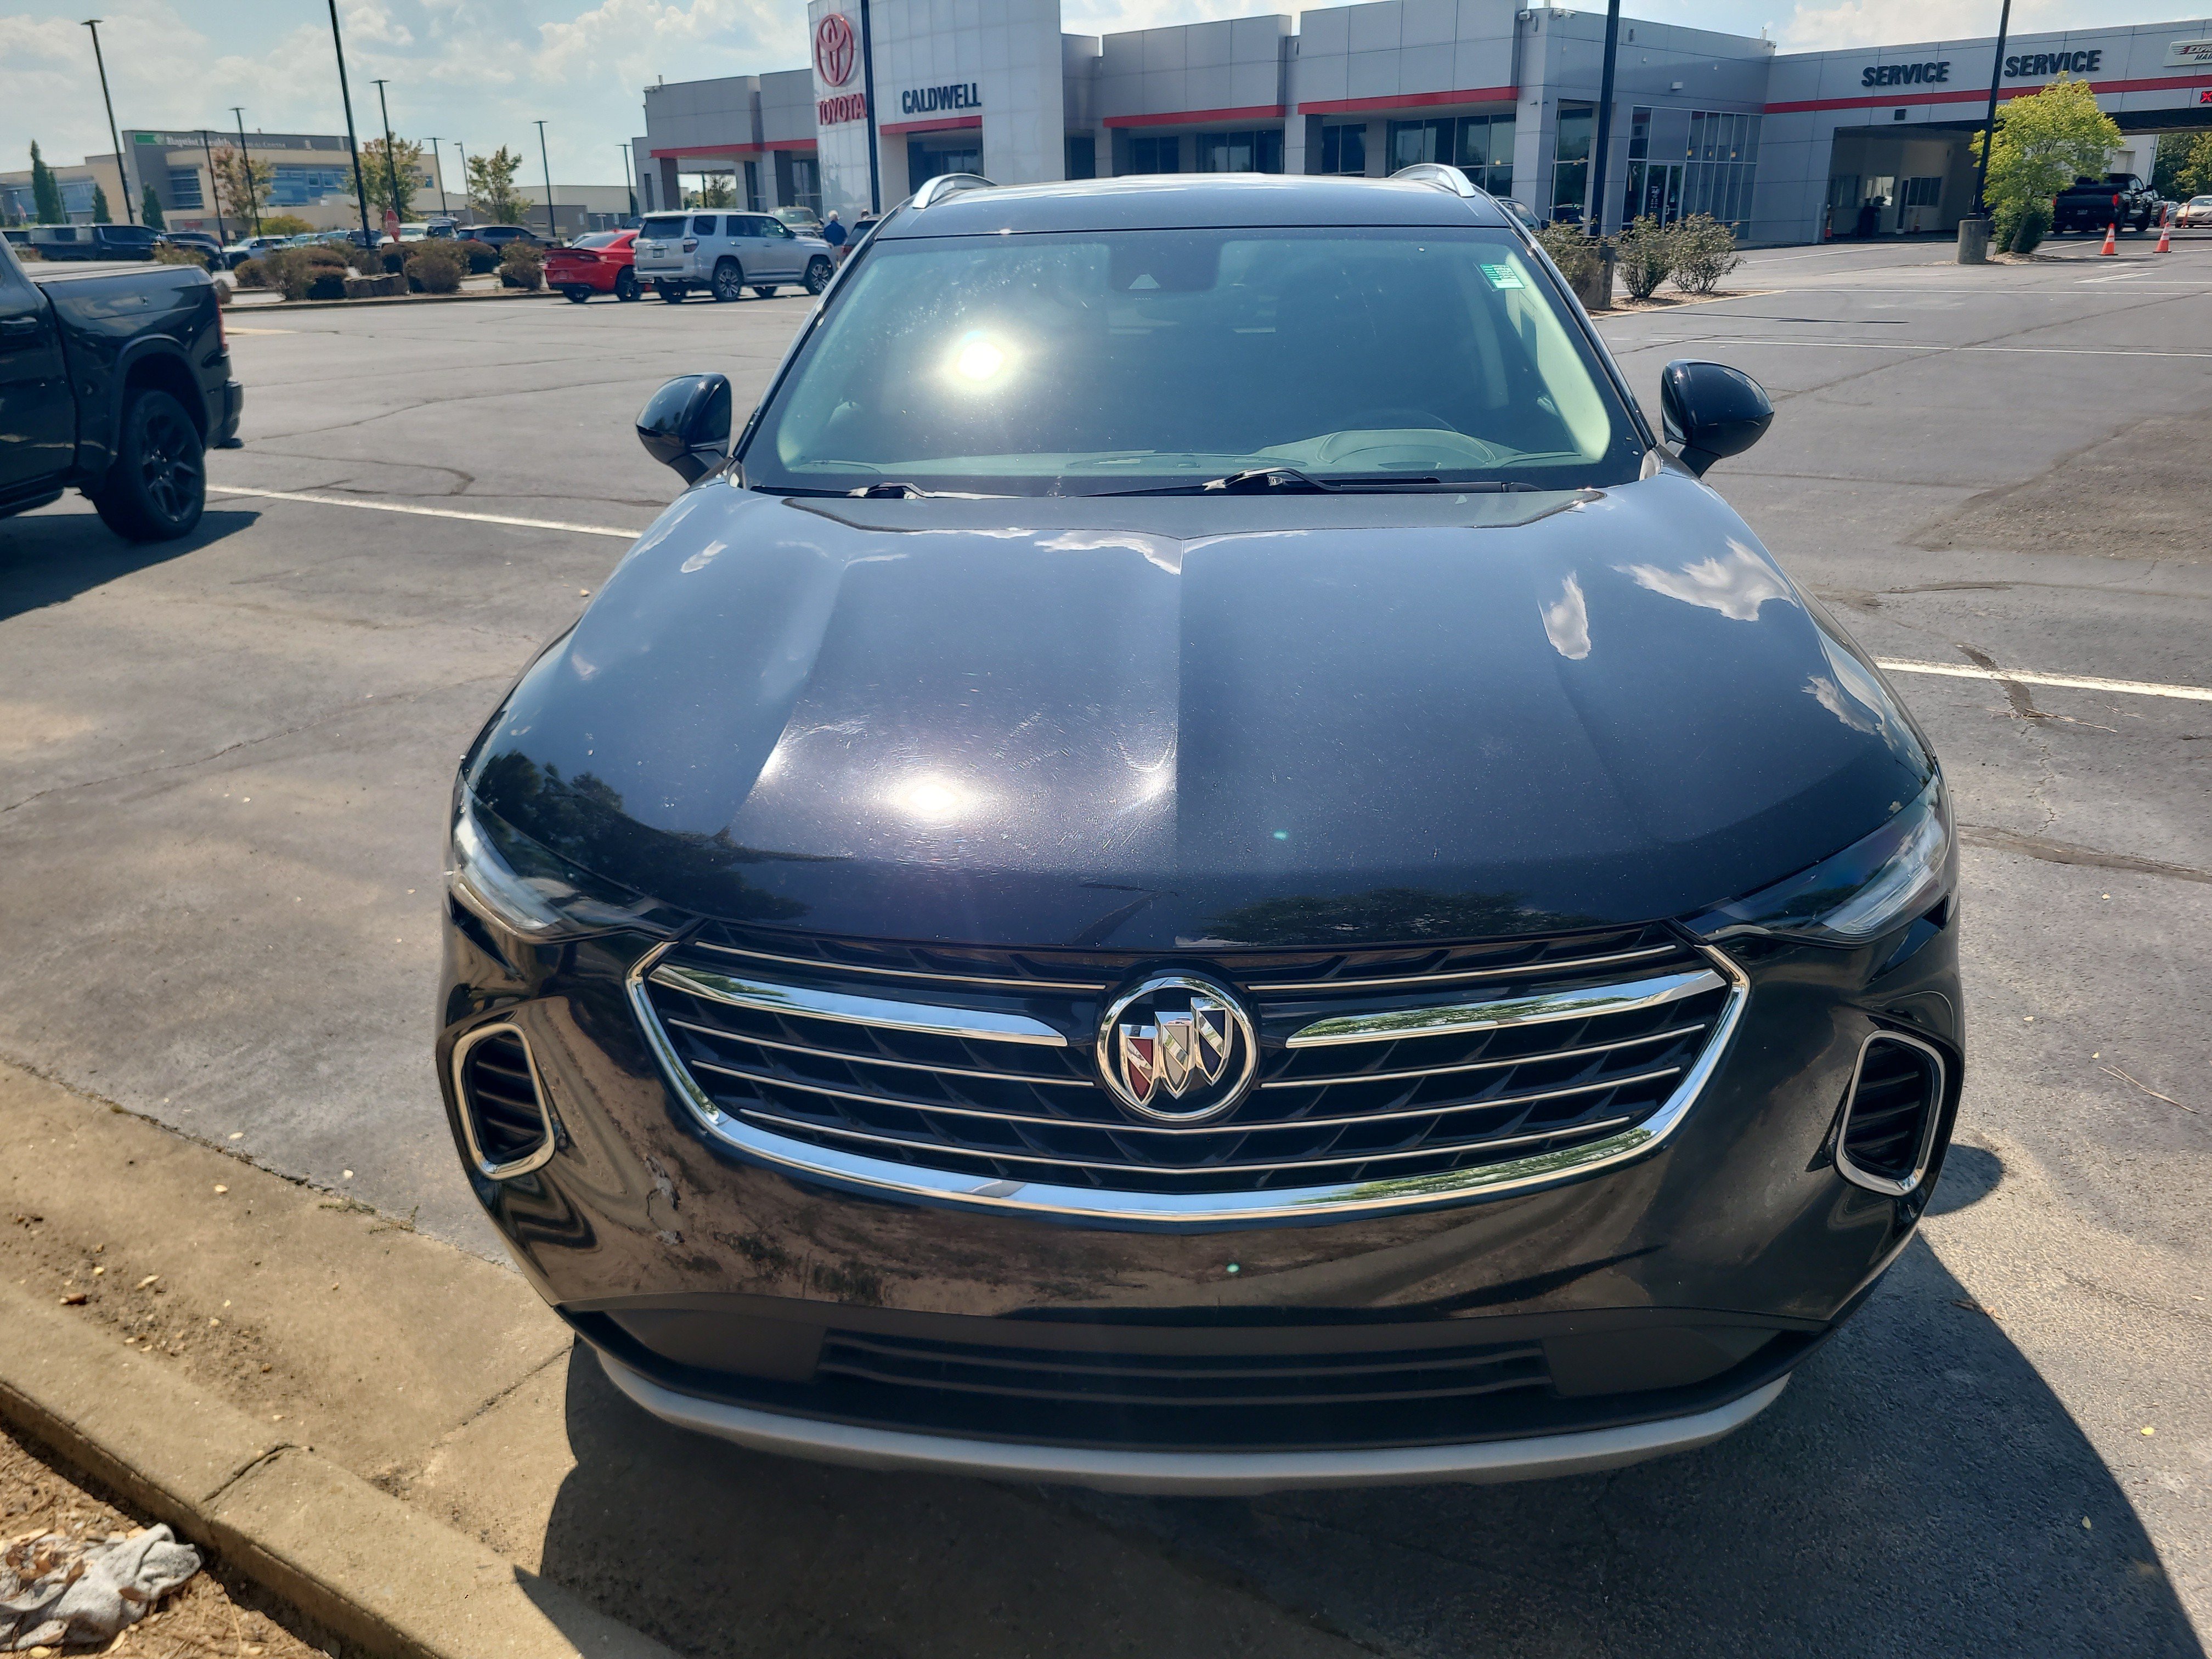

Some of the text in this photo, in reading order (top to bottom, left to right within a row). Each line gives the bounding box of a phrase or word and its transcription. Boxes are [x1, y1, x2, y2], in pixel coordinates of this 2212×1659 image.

[1861, 61, 1951, 87] SERVICE
[2004, 50, 2102, 77] SERVICE
[815, 93, 867, 125] TOYOTA
[902, 83, 982, 114] CALDWELL
